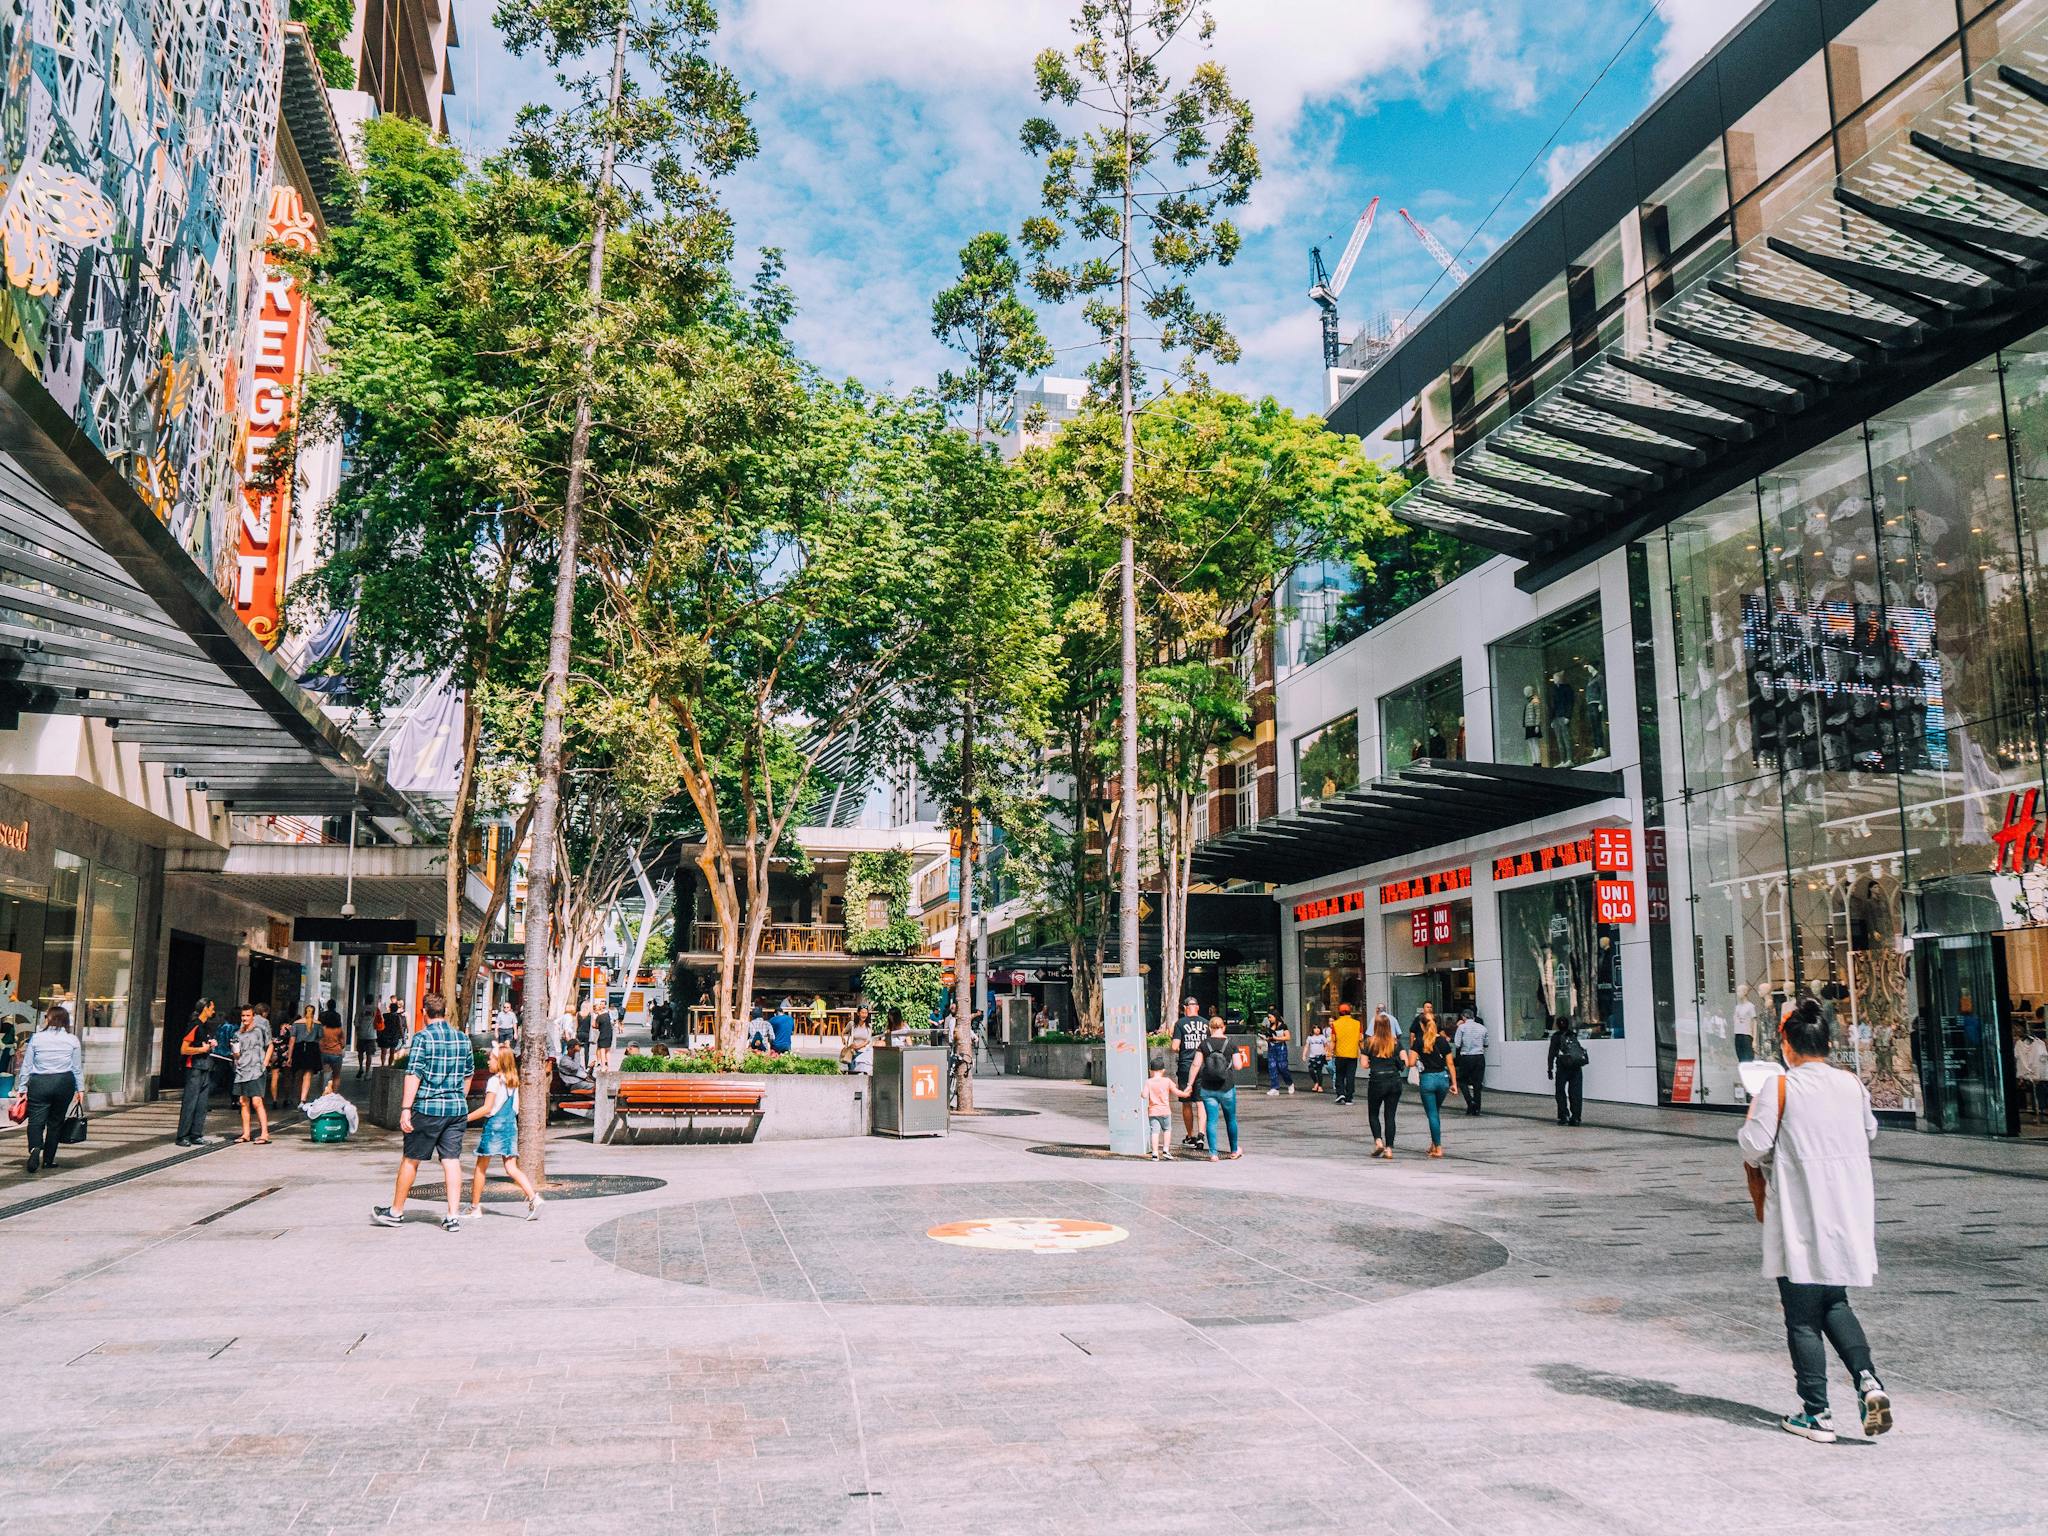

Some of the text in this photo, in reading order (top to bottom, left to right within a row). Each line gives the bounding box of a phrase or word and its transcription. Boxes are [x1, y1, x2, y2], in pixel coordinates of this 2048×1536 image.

[236, 264, 293, 605] REGENT
[1601, 885, 1628, 900] UNI
[1433, 910, 1448, 924] UNI
[1602, 902, 1632, 919] QLO
[1434, 925, 1449, 941] QLO
[1184, 949, 1220, 959] colette
[1183, 1021, 1208, 1034] DEUS
